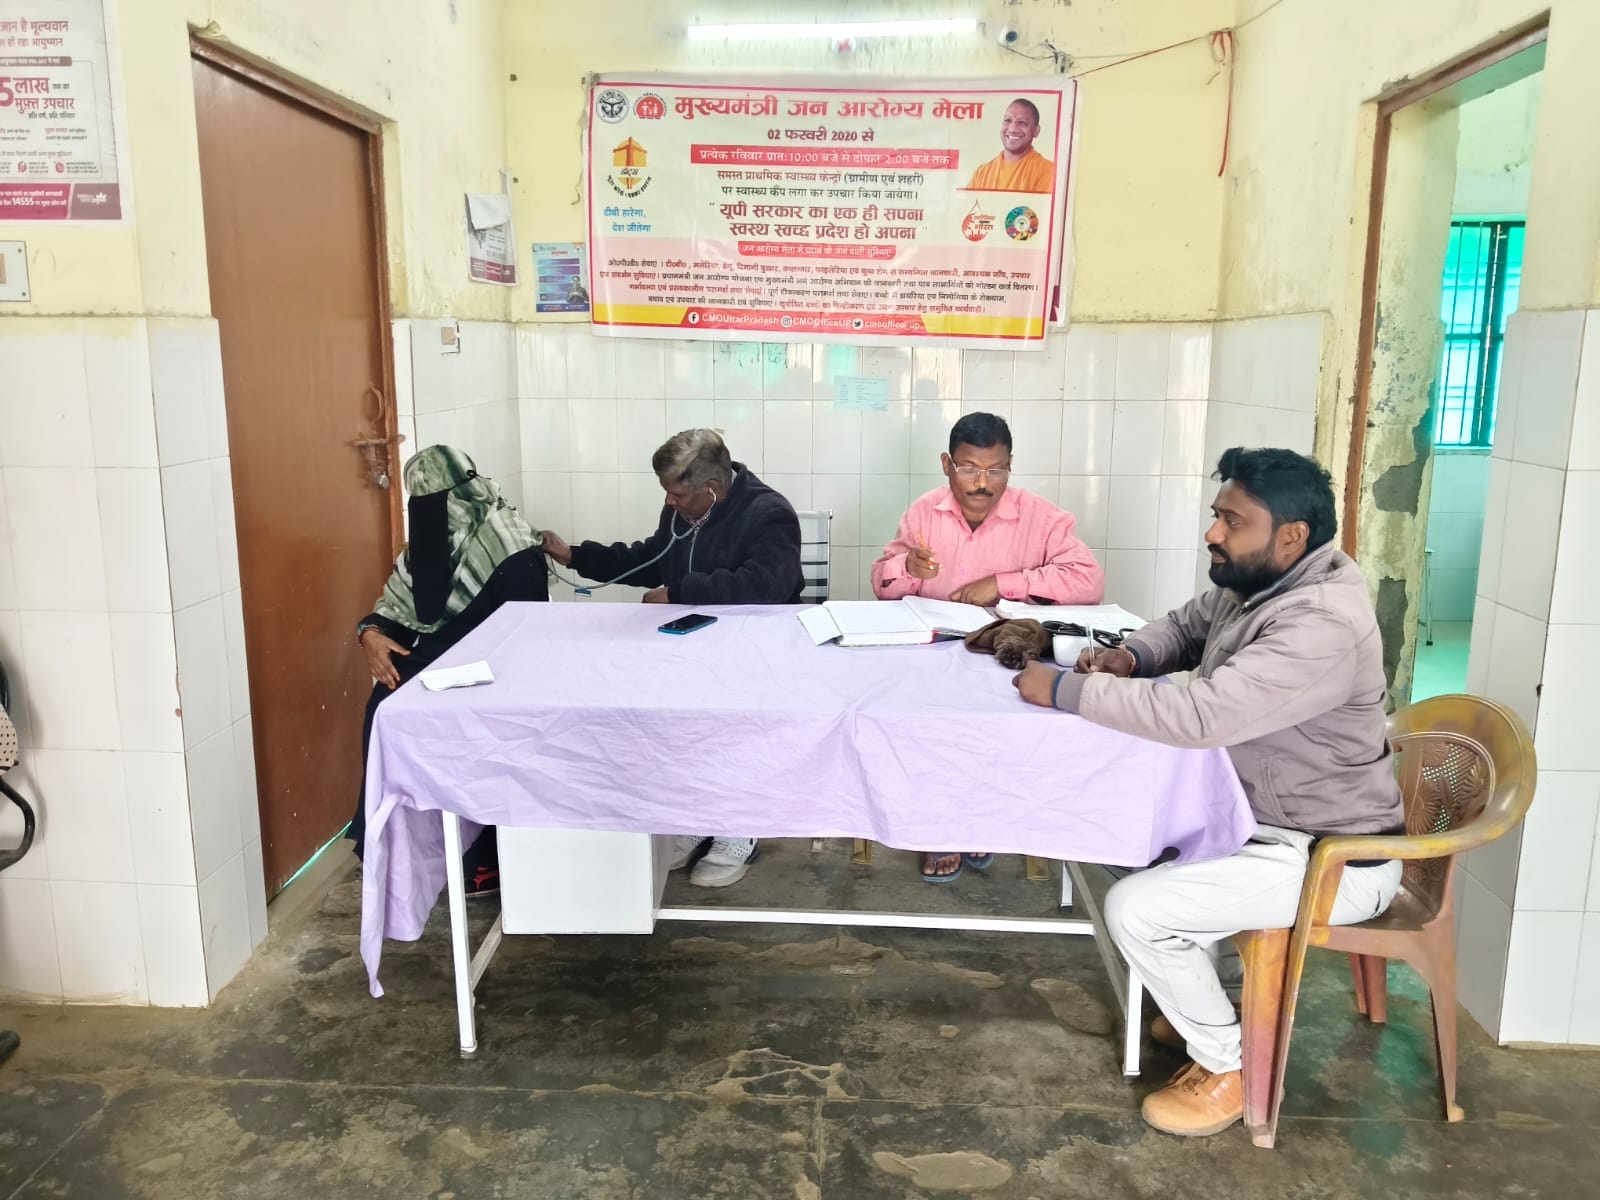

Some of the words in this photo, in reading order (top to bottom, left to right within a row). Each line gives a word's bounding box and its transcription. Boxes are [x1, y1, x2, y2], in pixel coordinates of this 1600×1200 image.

[20, 17, 28, 32] है
[30, 20, 68, 36] मूल्यवान
[13, 77, 50, 94] लाख
[42, 98, 75, 110] उपचार
[674, 93, 780, 120] मुख्यमंत्री
[788, 99, 828, 117] जन
[837, 97, 924, 119] आरोग्य
[932, 97, 984, 120] मेला
[767, 129, 781, 140] 02
[785, 125, 827, 141] फरवरी
[831, 130, 858, 142] 2020
[862, 127, 874, 142] से
[700, 149, 728, 162] प्रत्येक
[731, 149, 762, 161] रविवार
[821, 151, 838, 163] बजे
[932, 156, 950, 165] तक
[717, 170, 742, 180] समस्त
[745, 168, 782, 181] प्राथमिक
[786, 171, 816, 182] स्वास्थ्य
[844, 171, 878, 184] (ग्रामीण
[881, 171, 896, 185] एवं
[898, 171, 924, 185] शहरी)
[721, 185, 733, 195] पर
[736, 186, 766, 197] स्वास्थ्य
[789, 187, 807, 198] लगा
[810, 188, 824, 198] कर
[827, 188, 855, 198] उपचार
[858, 186, 881, 199] किया
[12, 198, 34, 206] 14555
[604, 206, 620, 216] टीबी
[720, 202, 747, 220] यूपी
[752, 205, 802, 218] सरकार
[808, 206, 828, 218] का
[834, 207, 858, 220] एक
[862, 204, 878, 221] ही
[884, 208, 924, 222] सपना
[612, 222, 624, 232] देश
[626, 222, 652, 232] जीतेगा
[730, 222, 769, 236] स्वस्थ
[815, 222, 849, 239] प्रदेश
[854, 222, 870, 240] हो
[874, 226, 916, 240] अपना
[702, 314, 778, 325] CMOUttarPradesh
